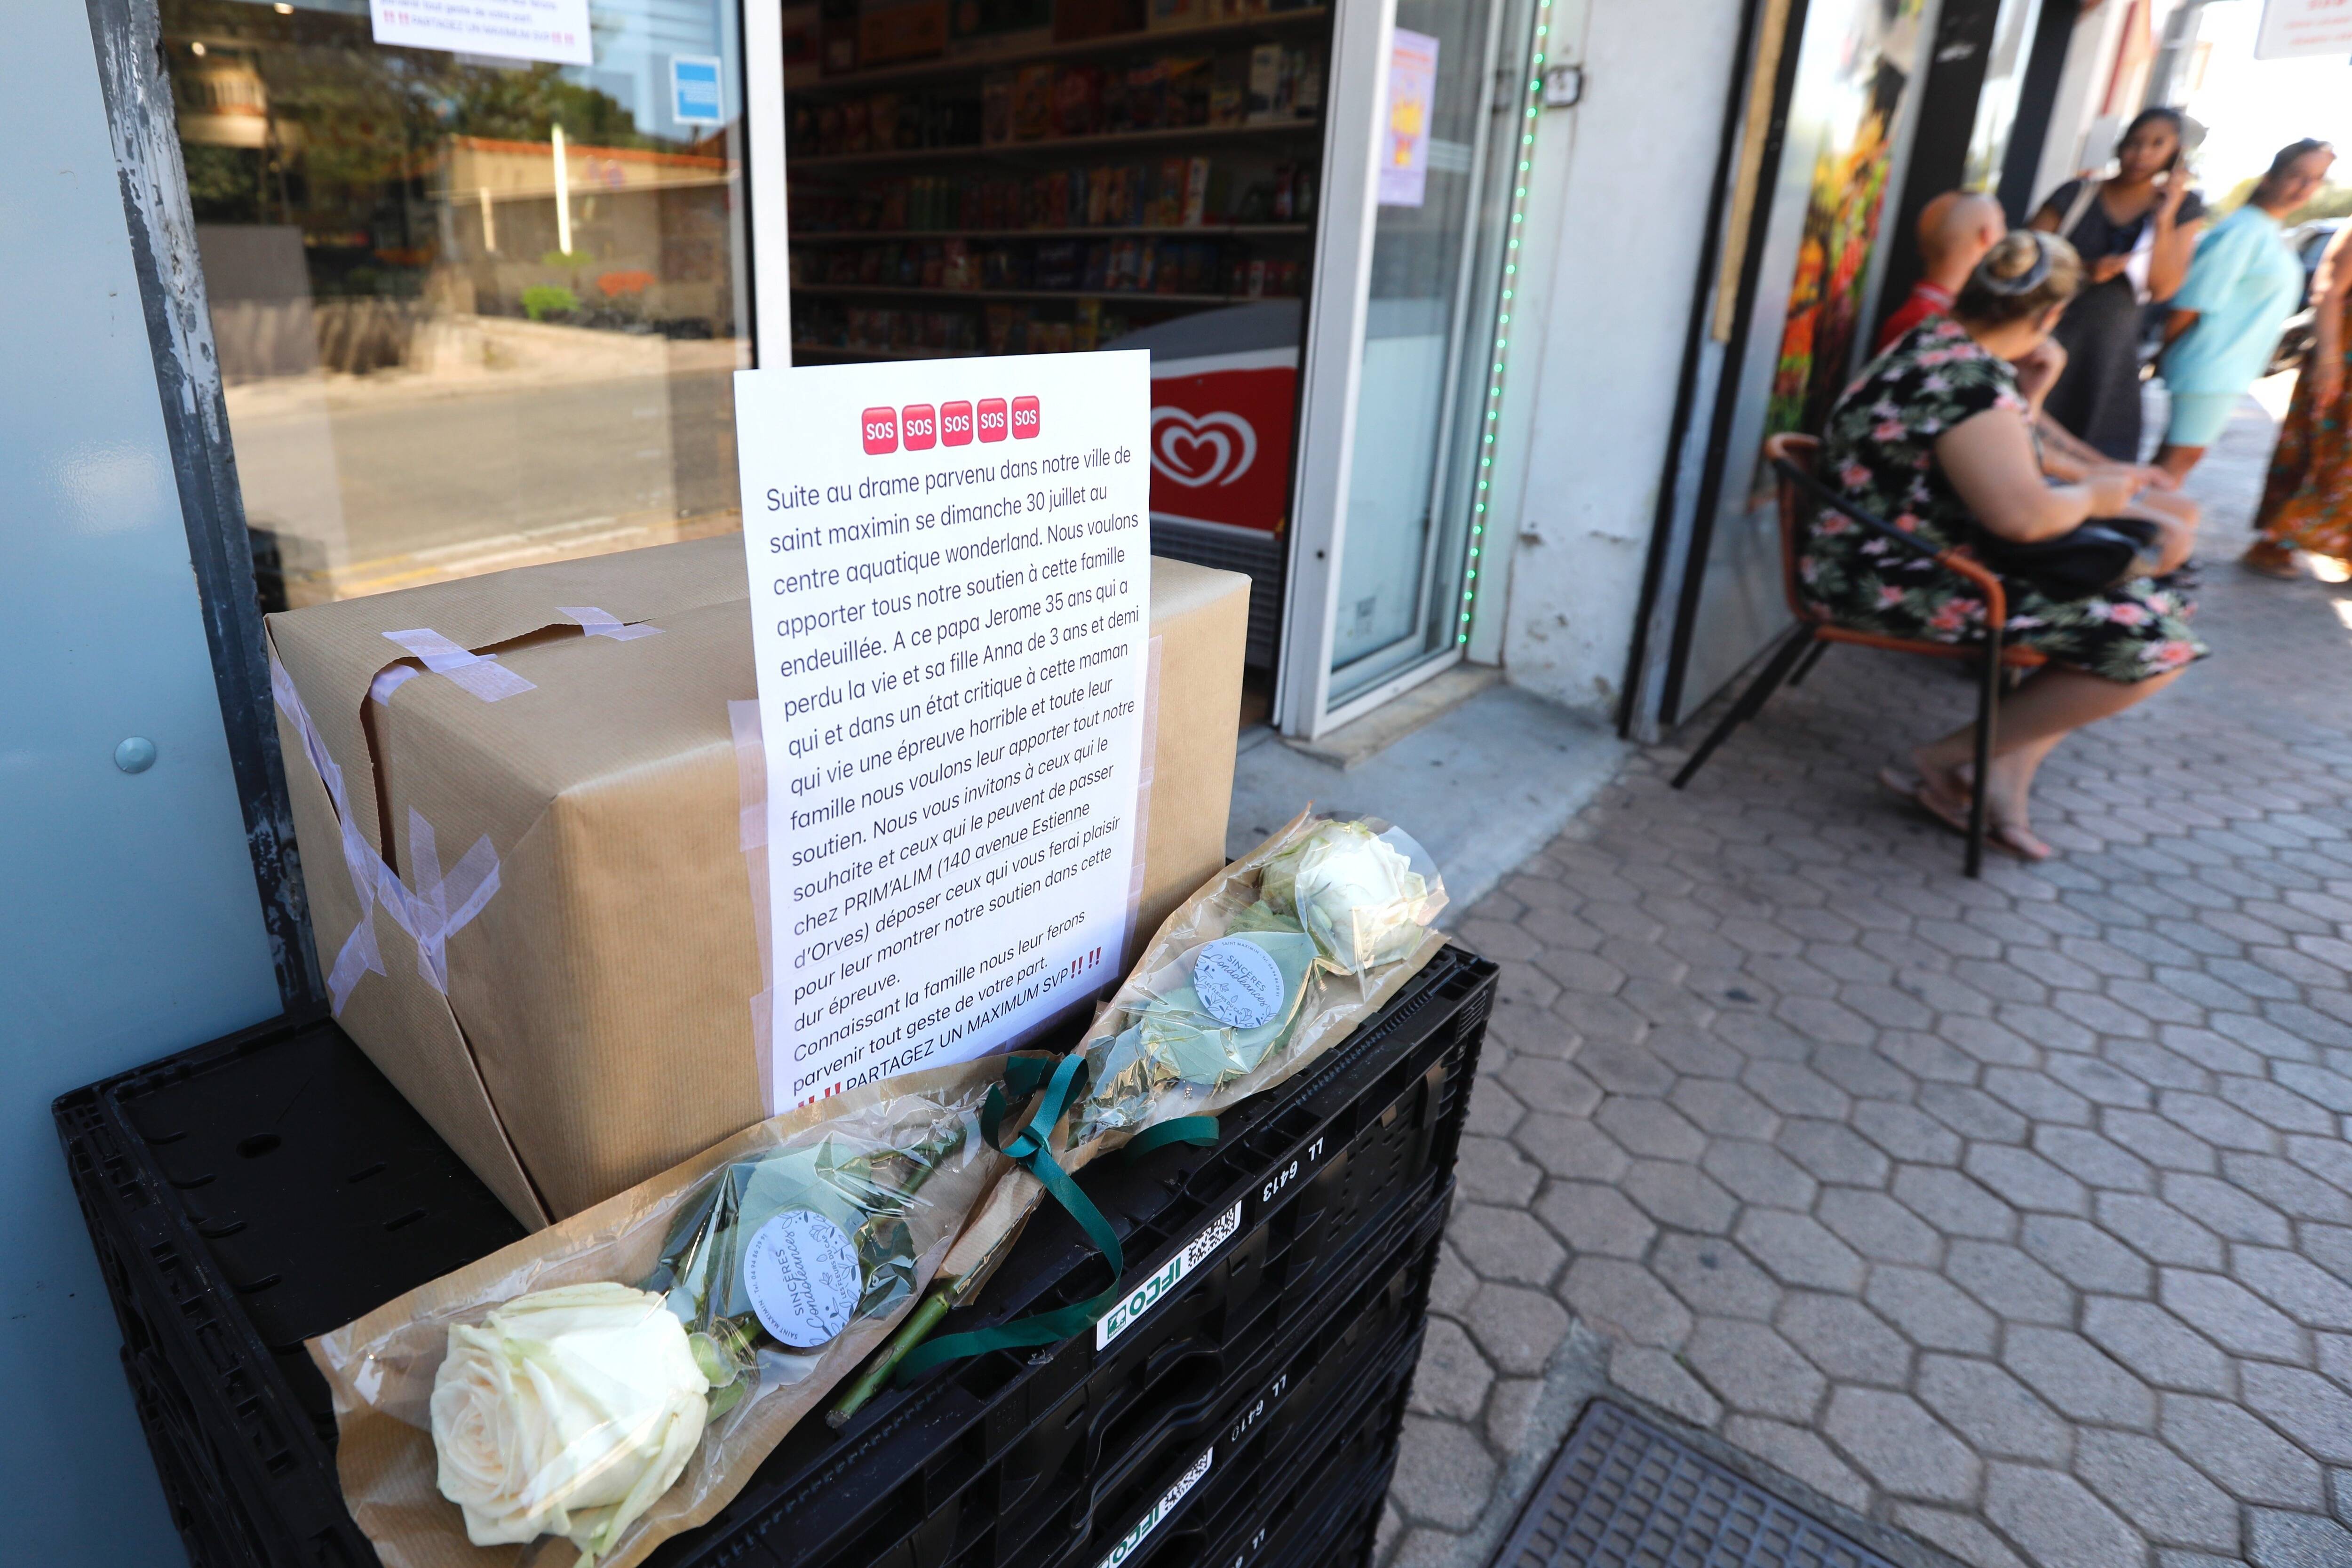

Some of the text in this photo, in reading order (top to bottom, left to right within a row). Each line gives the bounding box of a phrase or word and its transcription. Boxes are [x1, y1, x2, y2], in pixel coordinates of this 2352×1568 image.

[866, 408, 1037, 440] SOS SOS SOS SOS SOS
[766, 445, 1131, 512] Suite au drame parvenu dans notre ville de
[770, 486, 1107, 554] saint maximin se dimanche 30 juillet au
[773, 513, 1138, 596] centre aquatique wonderland. Nous voulons
[777, 546, 1125, 639] apporter tous notre soutien à cette famille
[780, 578, 1128, 677] endeuillée. A ce papa Jerome 35 ans qui a
[784, 605, 1139, 723] perdu la vie et sa fille Anna de 3 ans et demi
[788, 643, 1128, 759] qui et dans un état critique à cette maman
[791, 678, 1113, 797] qui vie une épreuve horrible et toute leur
[790, 700, 1135, 831] famille nous voulons leur apporter tout notre
[792, 737, 1108, 867] soutien. Nous vous invitons à ceux qui le
[793, 764, 1114, 902] souhaite et ceux qui le peuvent de passer
[794, 804, 1090, 936] chez PRIM'ALIM (140 avenue Estienne
[794, 816, 1120, 969] d'Orves) déposer ceux qui vous ferai plaisir
[795, 848, 1112, 1006] pour leur montrer notre soutien dans cette
[794, 911, 1085, 1062] Connaissant la famille nous leur ferons
[794, 974, 900, 1032] dur épreuve.
[794, 1046, 865, 1097] parvenir
[869, 1026, 902, 1054] tout
[906, 1006, 951, 1039] geste
[955, 995, 974, 1013] de
[978, 975, 1014, 1002] votre
[1017, 956, 1048, 986] part.
[940, 1024, 963, 1049] UN
[968, 983, 1039, 1035] MAXIMUM
[1212, 987, 1227, 1002] FLEURS
[1233, 1007, 1243, 1016] CAP
[1263, 1160, 1298, 1202] 6413
[785, 1229, 824, 1328] Condoléances
[822, 1234, 831, 1248] CAP
[827, 1250, 835, 1260] DU
[831, 1261, 844, 1286] FLEURS
[1129, 1260, 1181, 1316] IFCO
[779, 1328, 798, 1340] SAINT
[1112, 1506, 1160, 1564] IFCO
